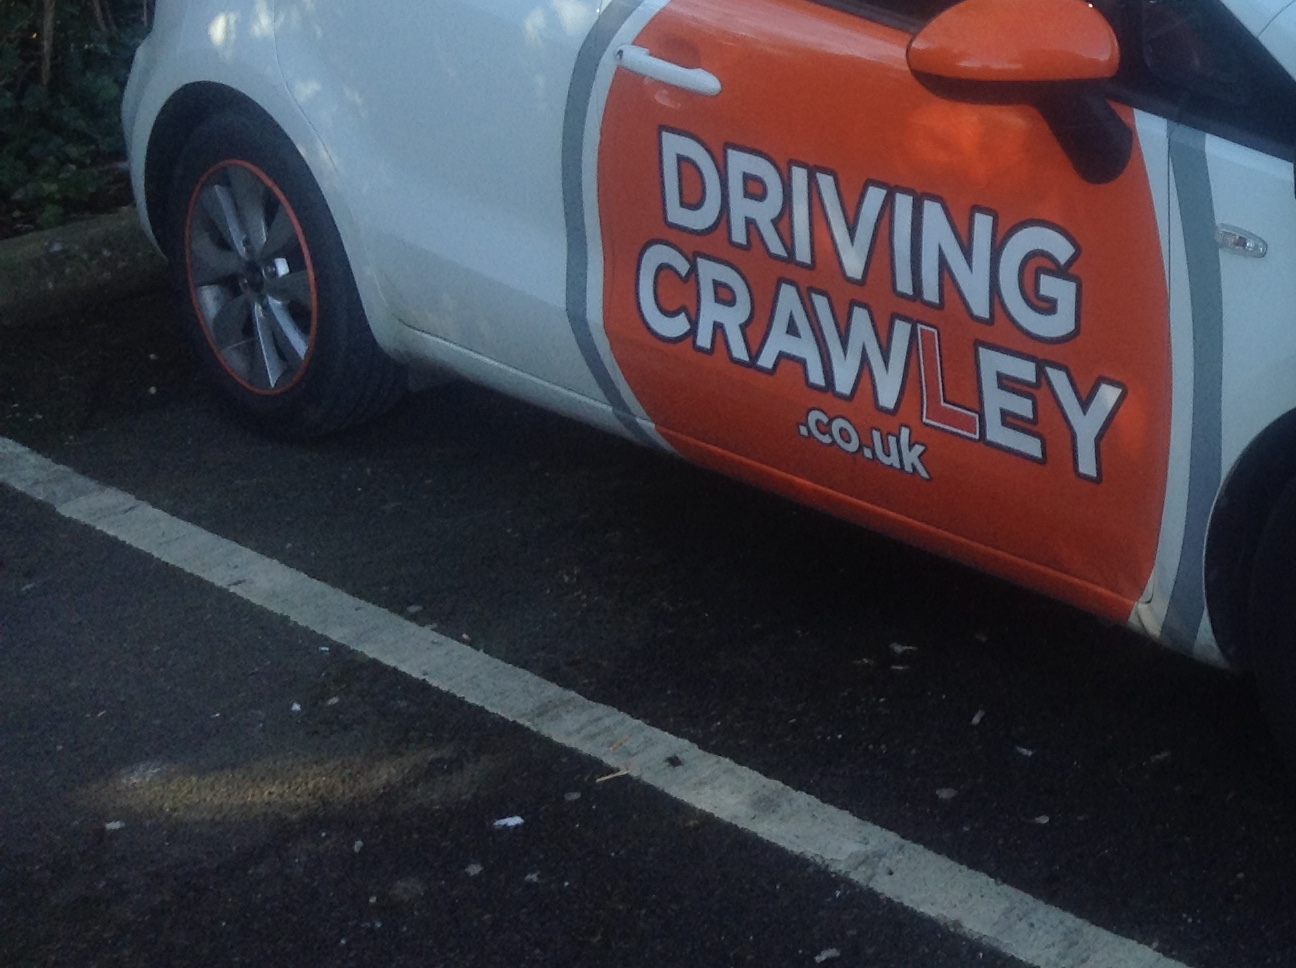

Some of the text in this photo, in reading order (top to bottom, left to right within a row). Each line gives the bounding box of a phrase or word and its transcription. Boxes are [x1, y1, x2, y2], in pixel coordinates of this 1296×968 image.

[659, 127, 1081, 341] DRIVING
[637, 240, 1126, 481] CRAWLEY
[799, 409, 932, 480] .co.uk
